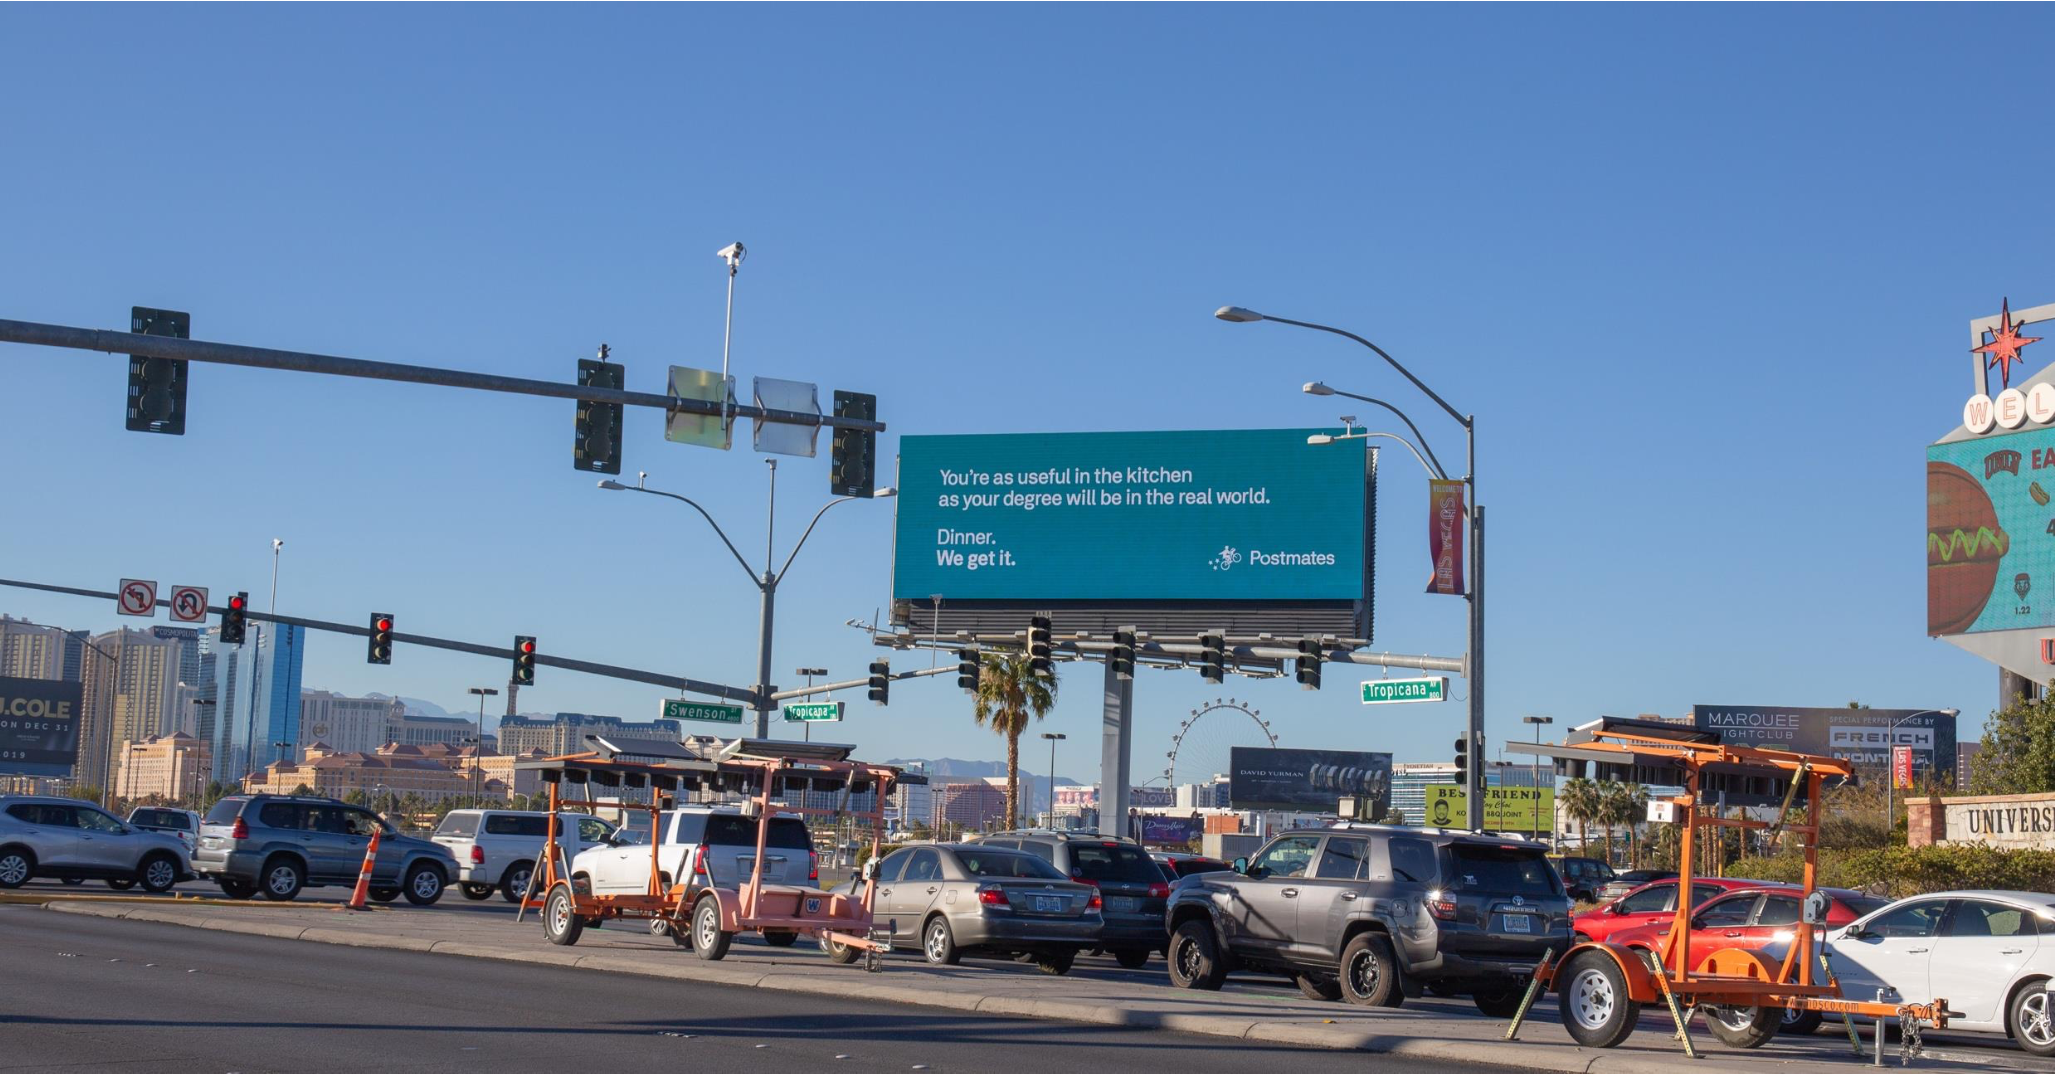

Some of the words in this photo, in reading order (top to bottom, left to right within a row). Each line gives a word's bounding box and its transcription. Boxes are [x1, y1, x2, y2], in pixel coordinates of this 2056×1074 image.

[1969, 392, 2049, 426] WEL
[939, 468, 989, 486] You’re
[993, 472, 1014, 485] as
[1017, 468, 1071, 485] useful
[1074, 467, 1090, 484] in
[1094, 467, 1123, 484] the
[1126, 466, 1193, 484] kitchen
[938, 494, 959, 507] as
[962, 493, 1000, 511] your
[1003, 490, 1063, 511] degree
[1066, 489, 1096, 506] will
[1100, 489, 1122, 506] be
[1126, 489, 1142, 505] in
[1145, 488, 1175, 505] the
[1178, 487, 1212, 505] real
[1216, 487, 1271, 504] world.
[937, 528, 996, 545] Dinner.
[936, 549, 963, 566] We
[967, 551, 995, 571] get
[999, 549, 1016, 566] it.
[1249, 550, 1335, 566] Postmates
[1437, 556, 1454, 589] LAS
[2014, 606, 2031, 615] 1.22
[159, 628, 199, 639] COSMOPOLITA
[1369, 682, 1426, 700] Tropicana
[670, 703, 726, 720] Swenson
[788, 705, 828, 719] Tropicana
[25, 722, 48, 730] DEC
[55, 724, 68, 732] 31
[1708, 712, 1800, 727] MARQUEE
[1723, 729, 1793, 739] IGHTCLUB
[1834, 732, 1929, 743] FRENCH
[1833, 752, 1930, 764] MONTA
[1144, 794, 1171, 803] LOVE
[1438, 788, 1466, 798] BES
[1484, 789, 1542, 800] FRIEND
[1968, 807, 2055, 834] UNIVERS
